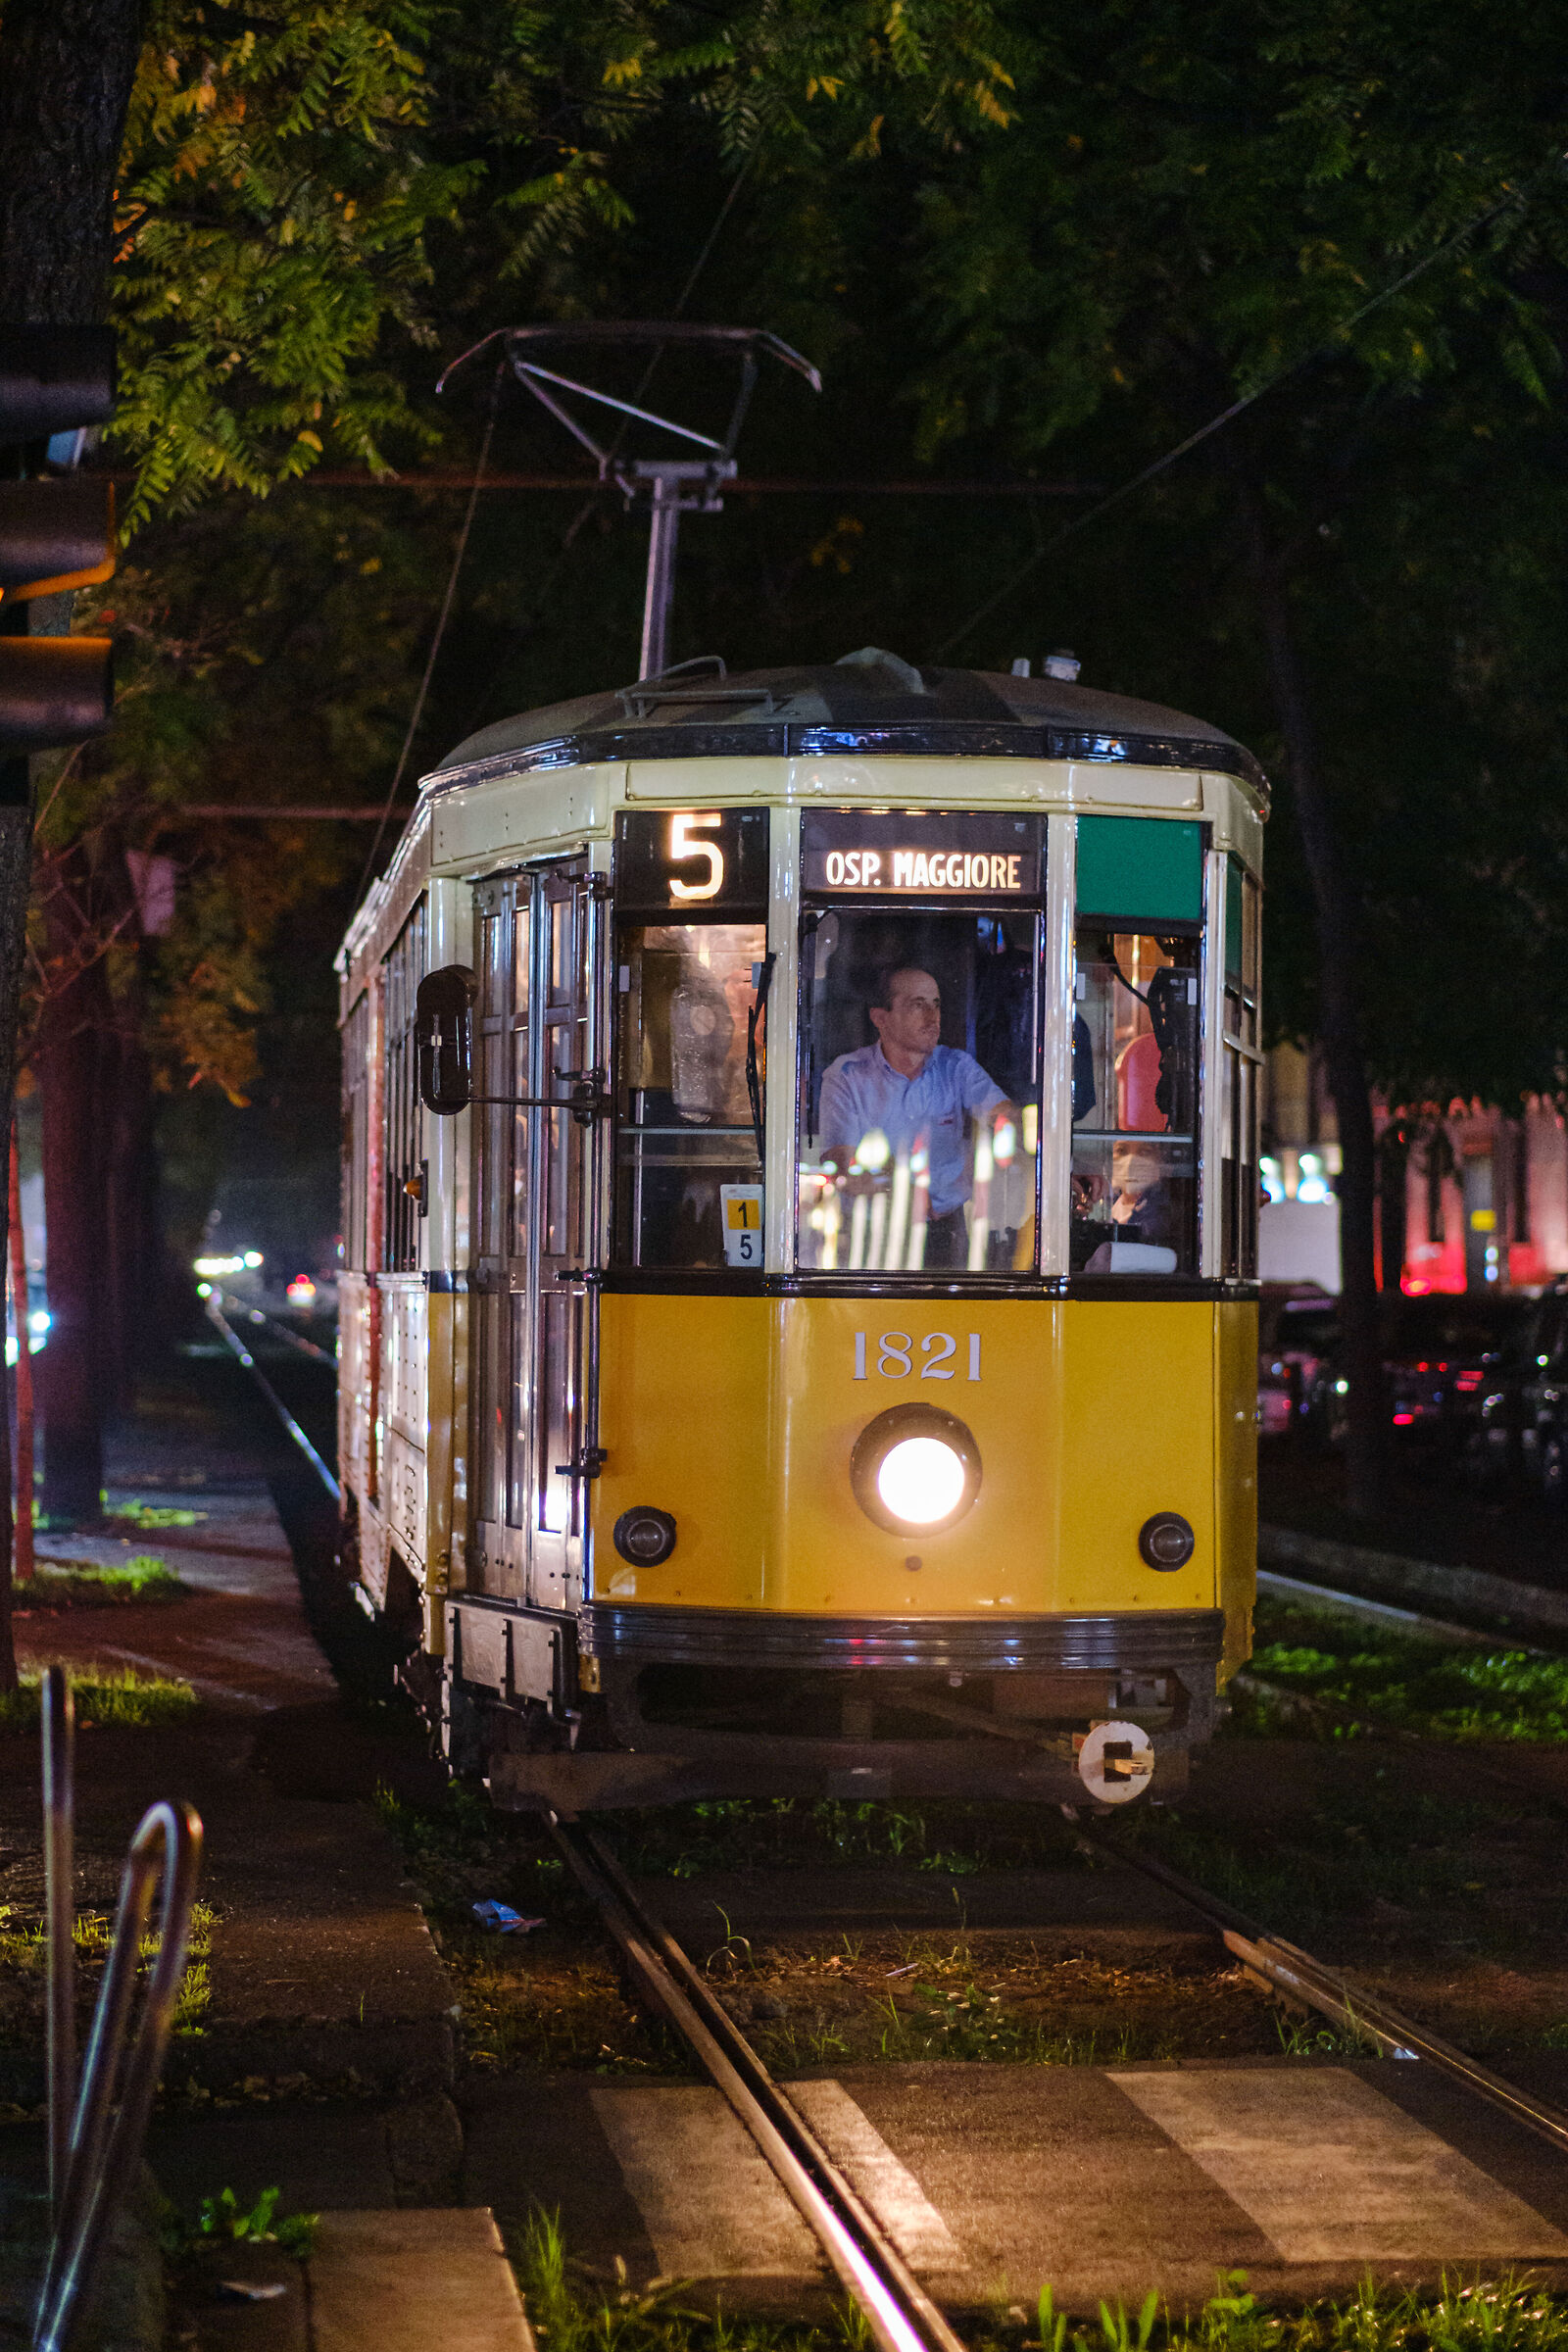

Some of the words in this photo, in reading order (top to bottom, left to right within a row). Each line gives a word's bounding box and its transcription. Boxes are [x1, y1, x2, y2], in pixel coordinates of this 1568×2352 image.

[668, 813, 724, 900] 5
[825, 851, 882, 887] OSP.
[893, 852, 1022, 889] MAGGIORE
[738, 1200, 748, 1228] 1
[740, 1234, 753, 1260] 5
[852, 1331, 982, 1381] 1821
